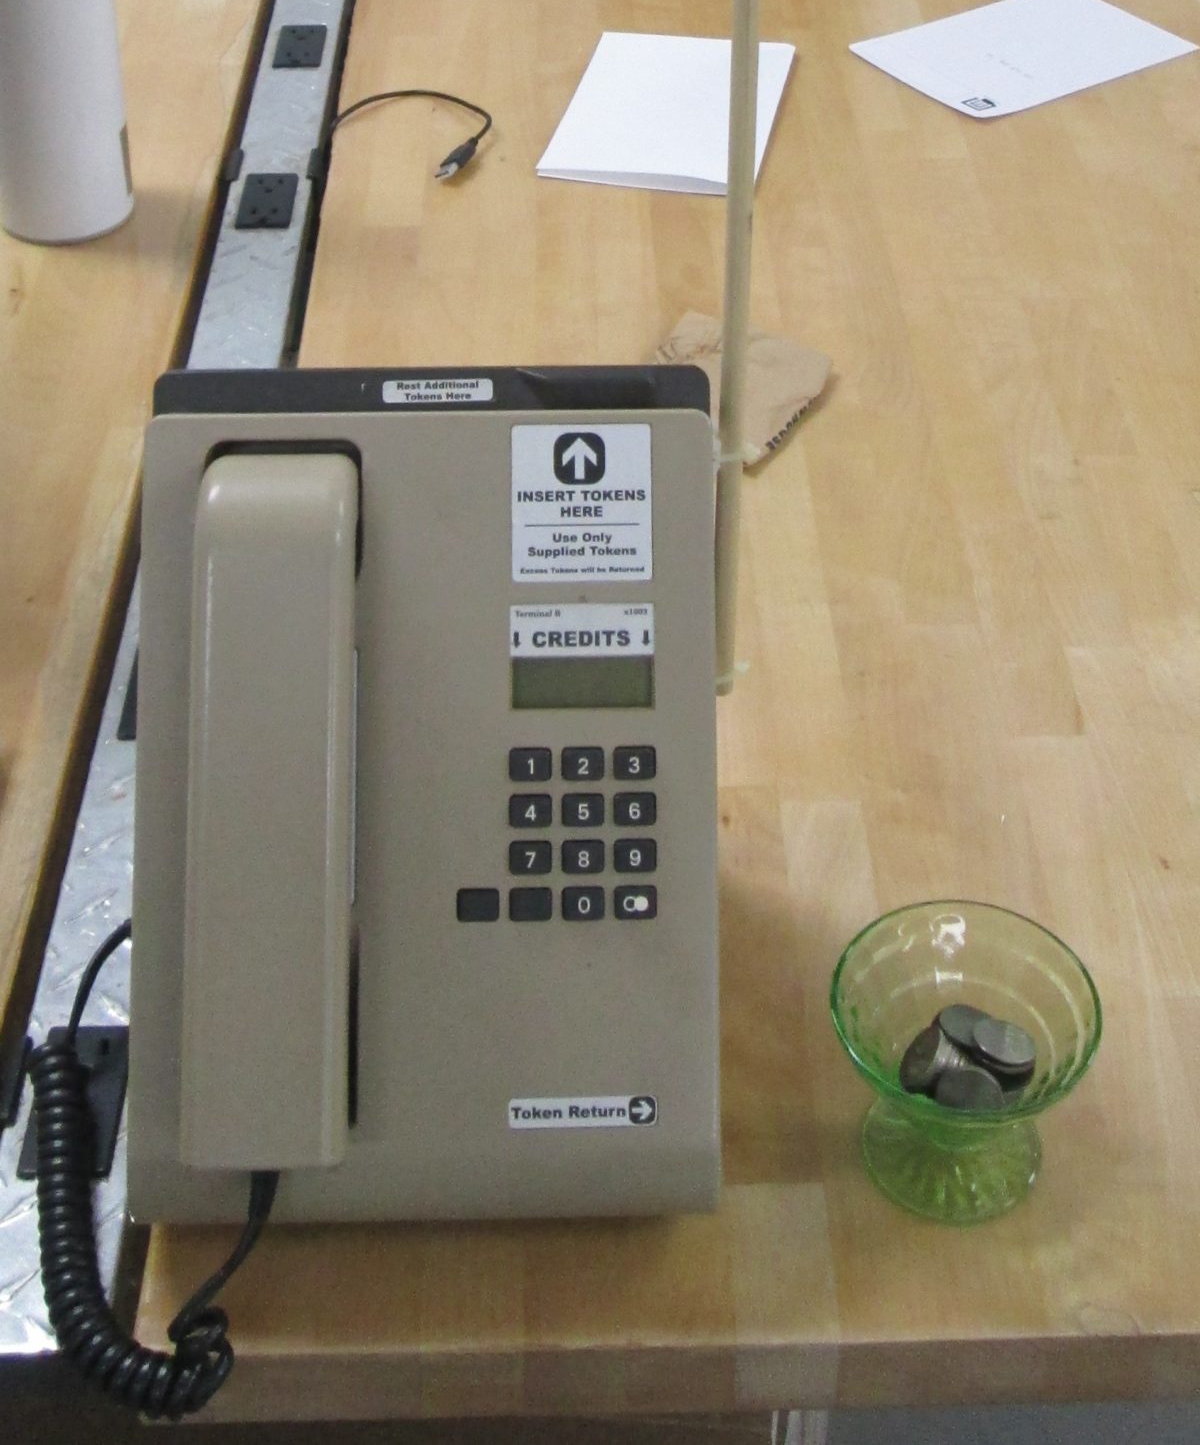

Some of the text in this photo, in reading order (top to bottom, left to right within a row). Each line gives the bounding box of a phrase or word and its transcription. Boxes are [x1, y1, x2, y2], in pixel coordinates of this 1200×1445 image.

[396, 380, 479, 391] Rest Additional
[405, 392, 472, 401] Tokens Here
[517, 489, 646, 503] INSERT TOKENS
[560, 506, 603, 518] HERE
[552, 532, 613, 544] Use Only
[527, 546, 637, 559] Supplied Tokens
[551, 566, 578, 574] Tokens
[580, 566, 595, 574] will
[514, 609, 552, 618] Terminal
[532, 630, 631, 648] CREDITS
[577, 757, 589, 775] 2
[628, 756, 640, 774] 3
[525, 805, 537, 821] 4
[578, 804, 589, 820] 5
[628, 802, 641, 819] 6
[525, 851, 536, 869] 7
[578, 850, 590, 868] 8
[629, 849, 641, 866] 9
[578, 896, 590, 914] 0
[511, 1105, 626, 1120] Token Return
